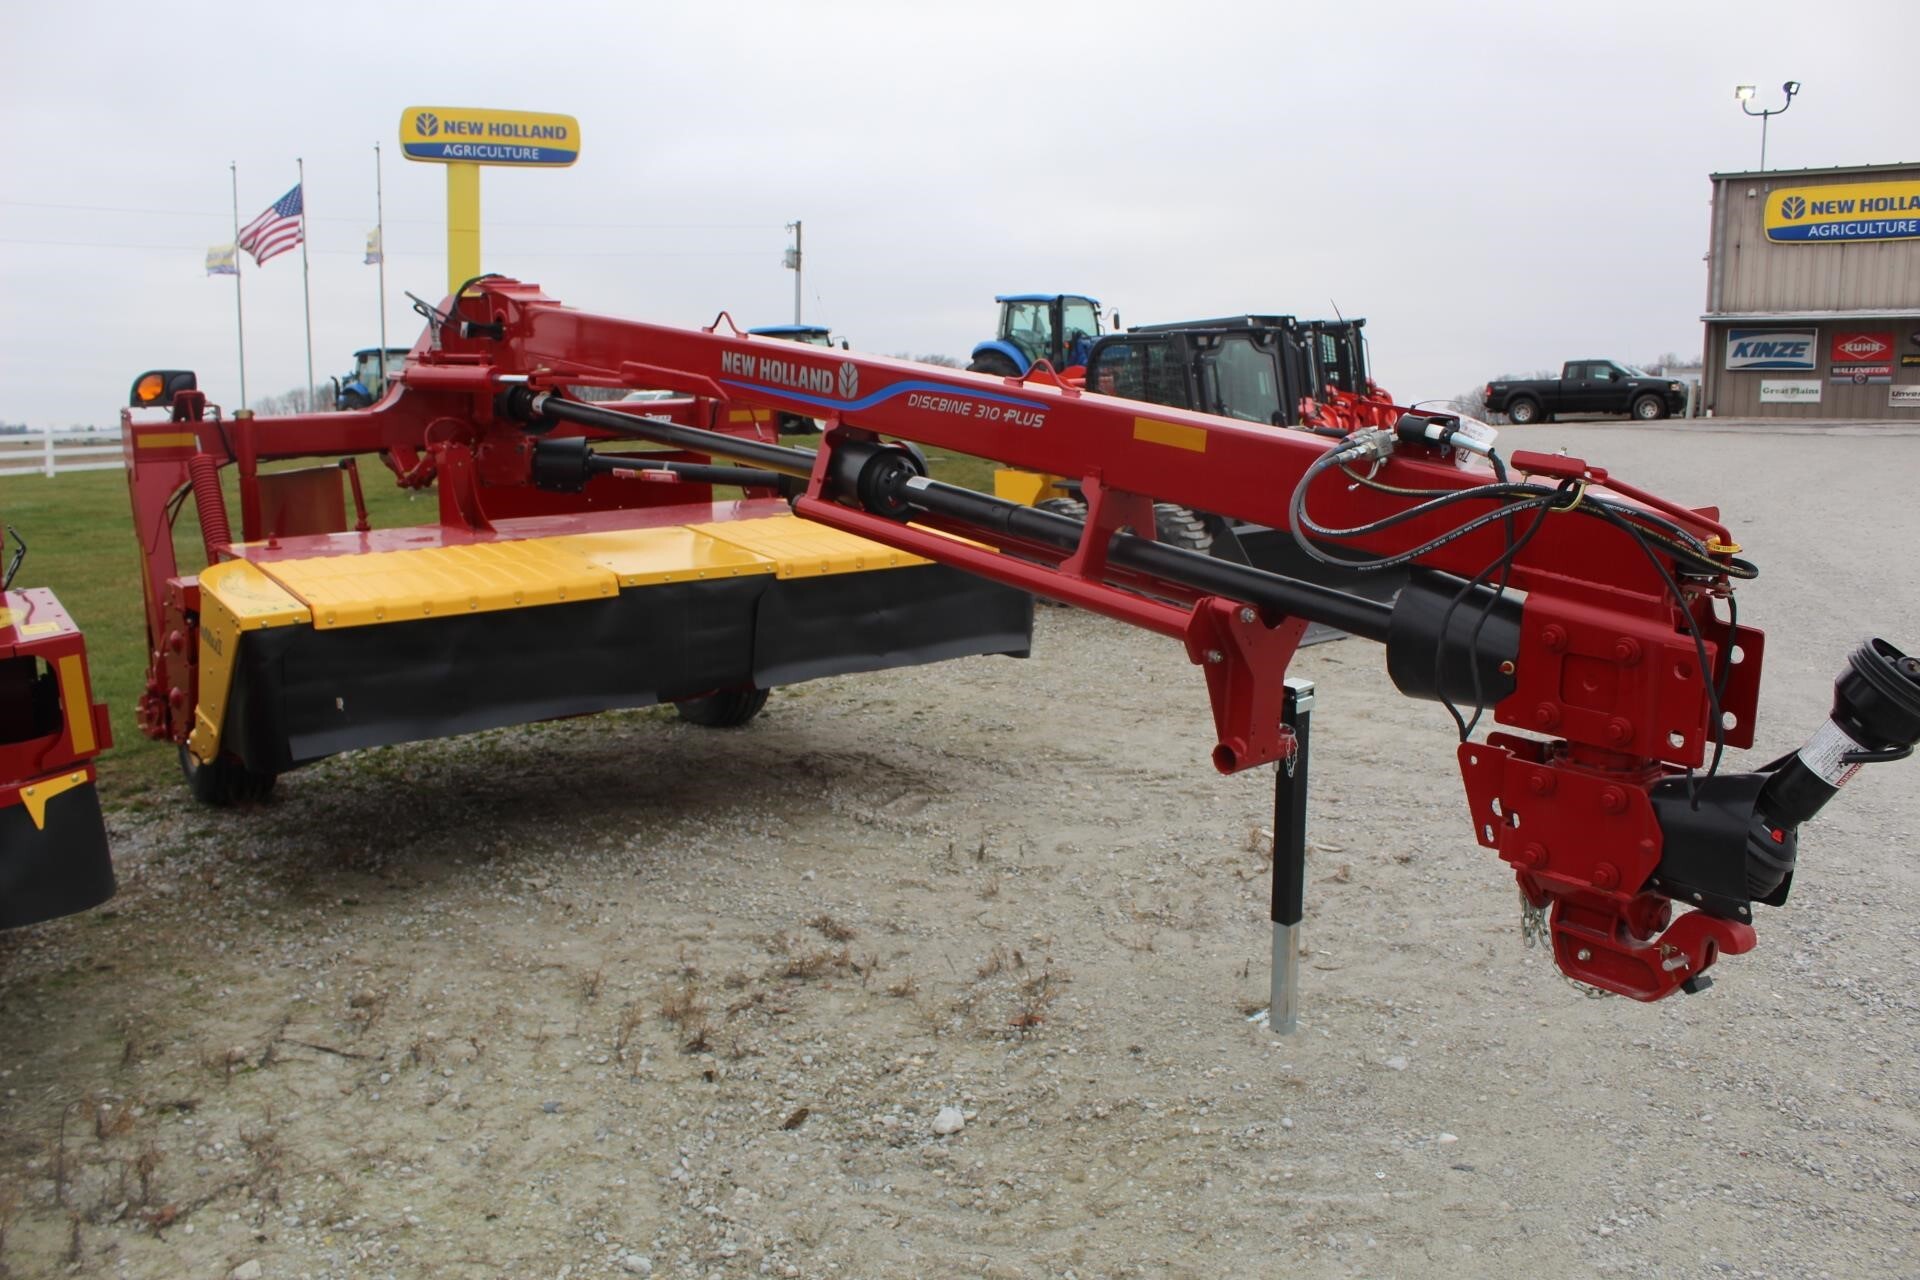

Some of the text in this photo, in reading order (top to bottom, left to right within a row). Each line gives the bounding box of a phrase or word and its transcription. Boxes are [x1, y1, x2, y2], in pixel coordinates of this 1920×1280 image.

[443, 120, 567, 140] NEW HOLLAND
[442, 143, 540, 160] AGRICULTURE
[1811, 199, 1855, 215] NEW
[1808, 220, 1917, 237] AGRICULTURE
[1732, 341, 1811, 358] KINZE
[1845, 343, 1880, 352] KUHN
[722, 350, 834, 394] NEW HOLLAND
[1762, 387, 1819, 395] Great Plains
[908, 393, 972, 416] DISCBINE
[975, 404, 1000, 421] 310
